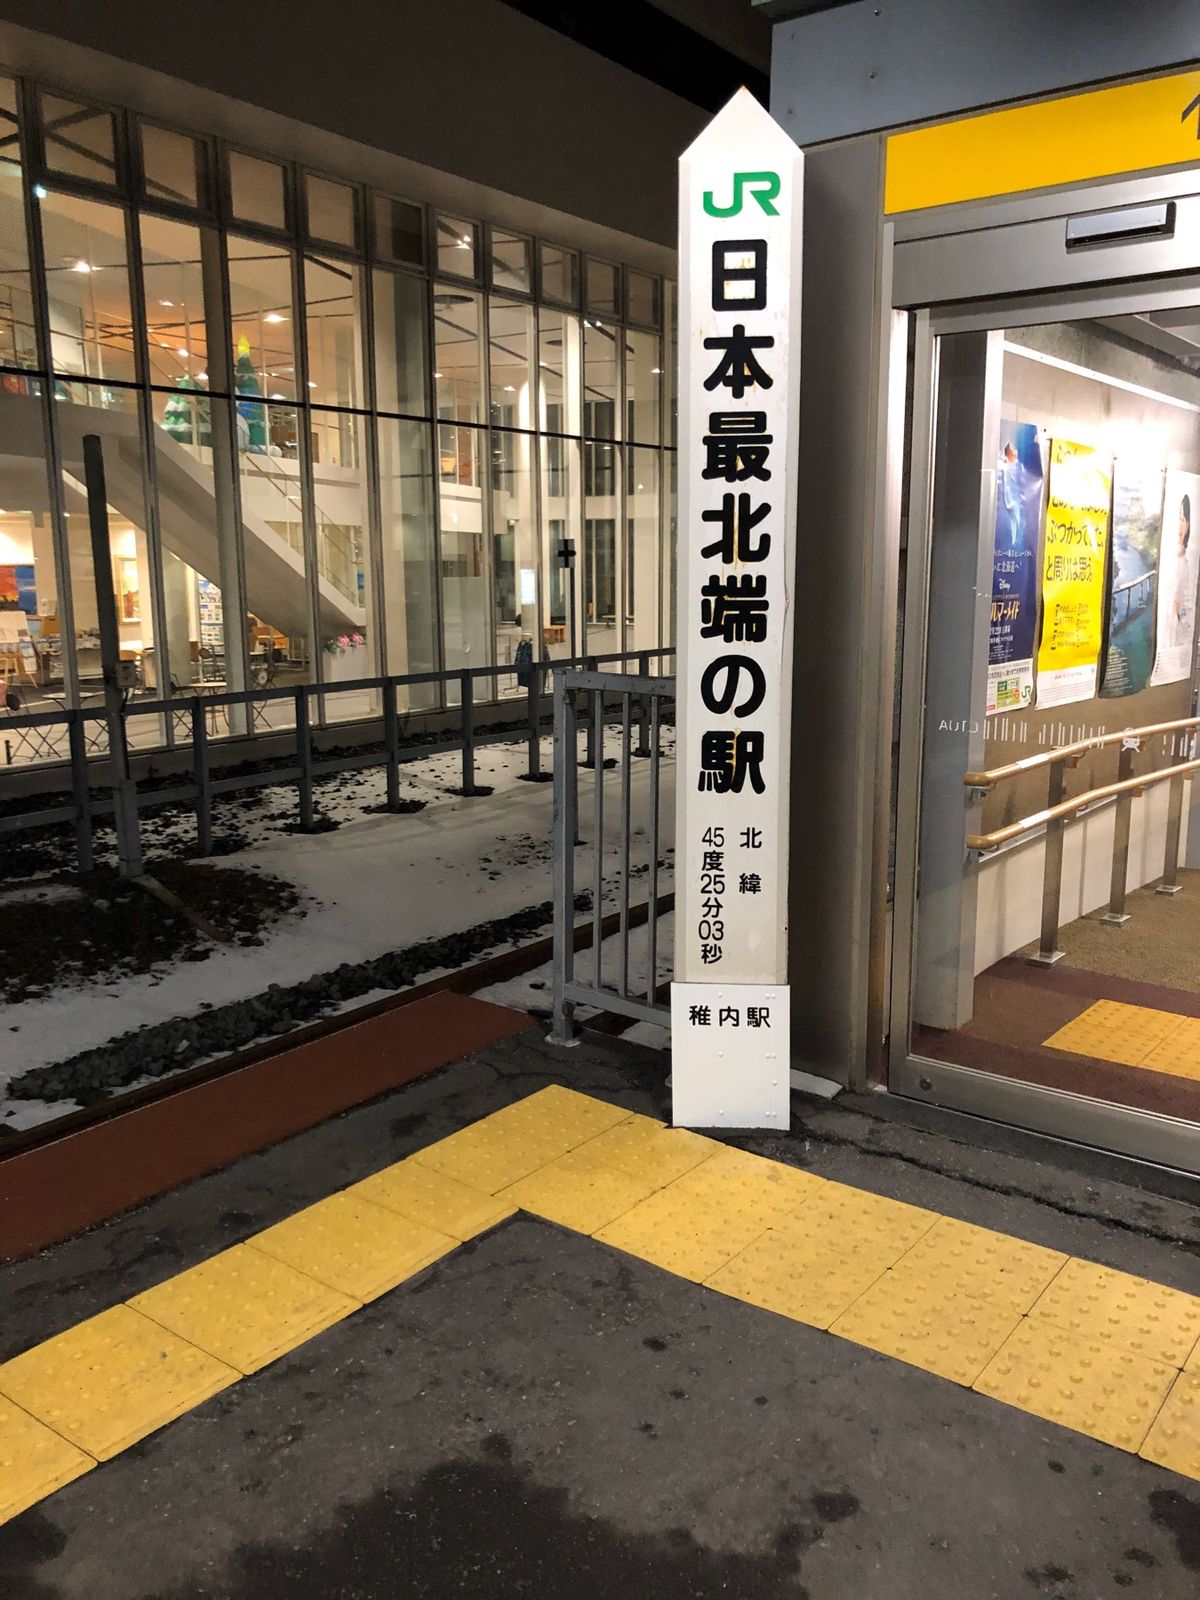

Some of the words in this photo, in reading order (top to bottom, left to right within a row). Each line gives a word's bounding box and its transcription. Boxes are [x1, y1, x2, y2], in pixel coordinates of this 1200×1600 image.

[703, 172, 780, 218] JR
[700, 239, 775, 796] 日本最北端の駅
[1047, 519, 1104, 548] ぶつかってた
[1021, 685, 1031, 699] JR
[739, 827, 763, 895] 北緯
[698, 827, 726, 964] 45度25分03秒
[689, 1005, 771, 1028] 稚内駅
